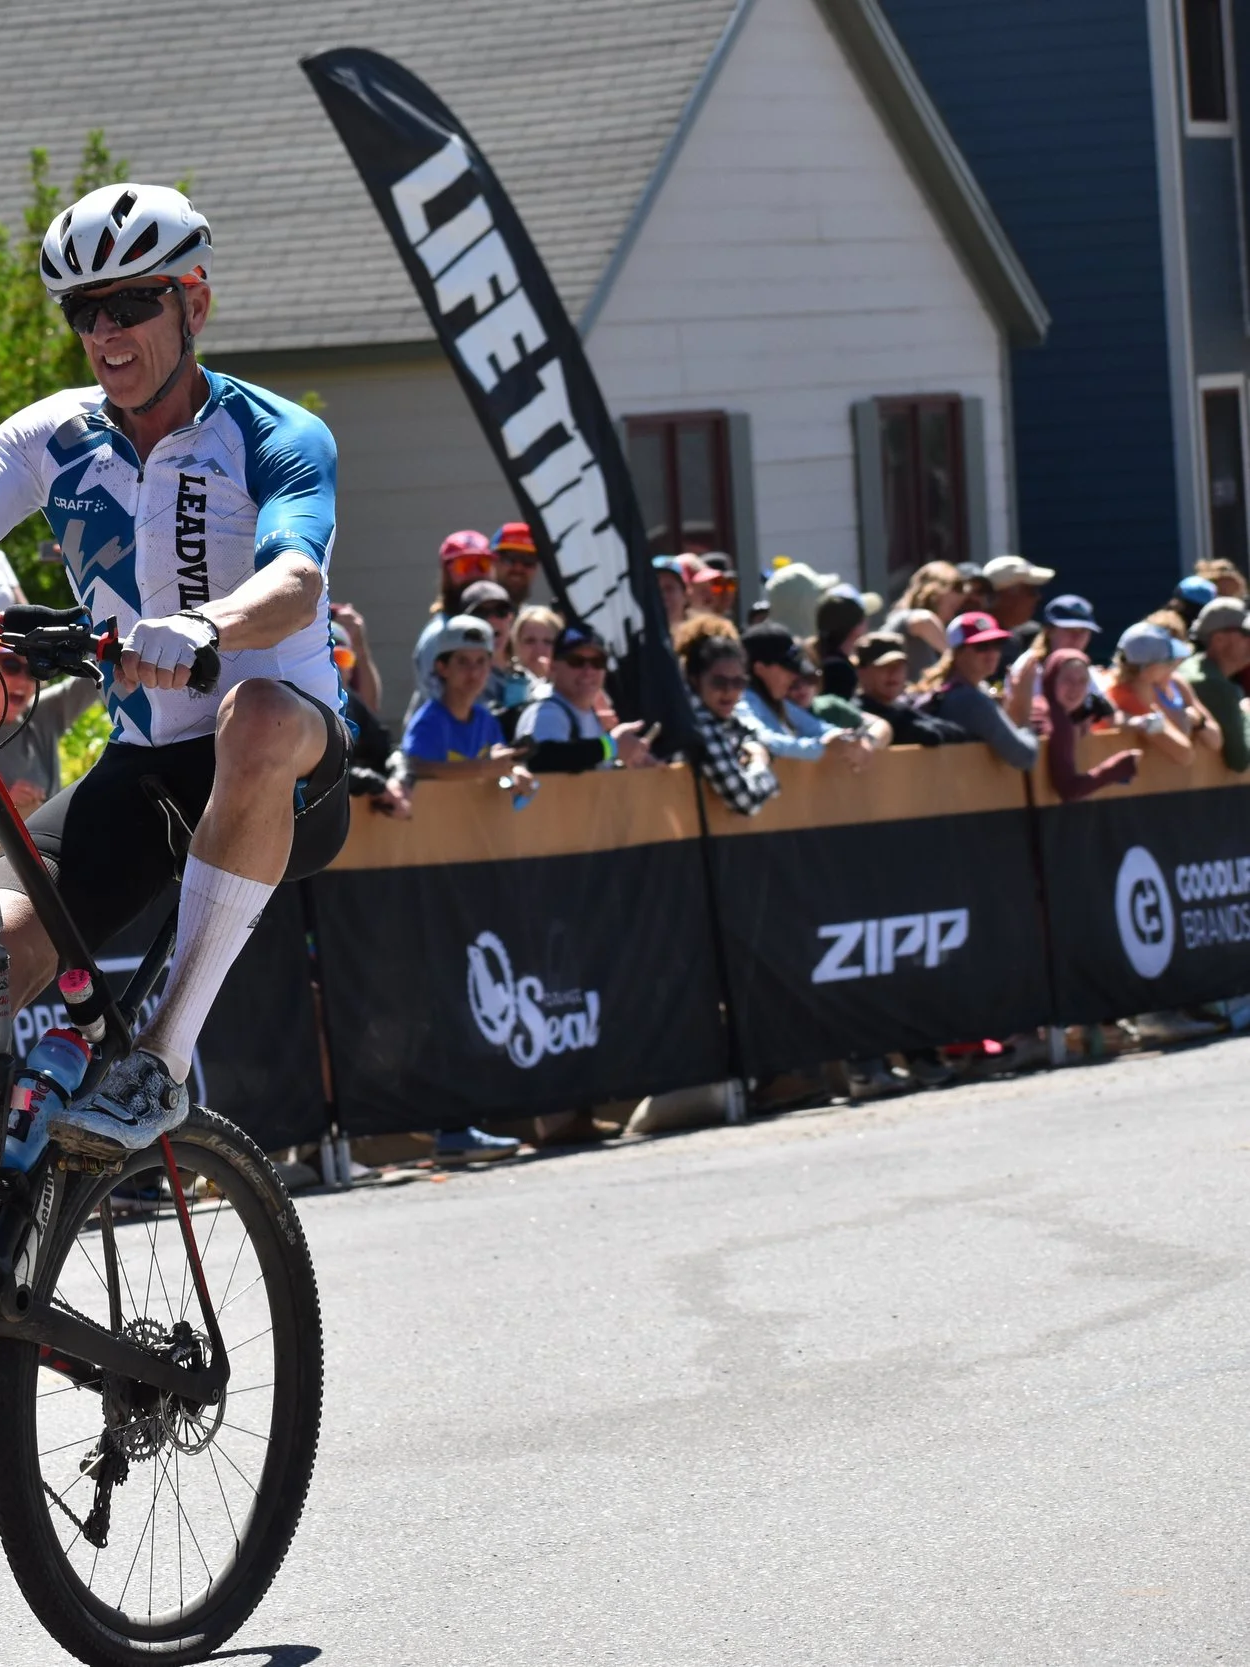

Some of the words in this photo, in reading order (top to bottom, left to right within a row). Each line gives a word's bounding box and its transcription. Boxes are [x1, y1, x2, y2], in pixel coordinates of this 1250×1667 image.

[53, 496, 94, 512] CRAFT
[175, 472, 211, 611] LEADVIL
[255, 528, 283, 553] AFT
[810, 907, 970, 984] ZIPP
[506, 975, 600, 1069] Seal
